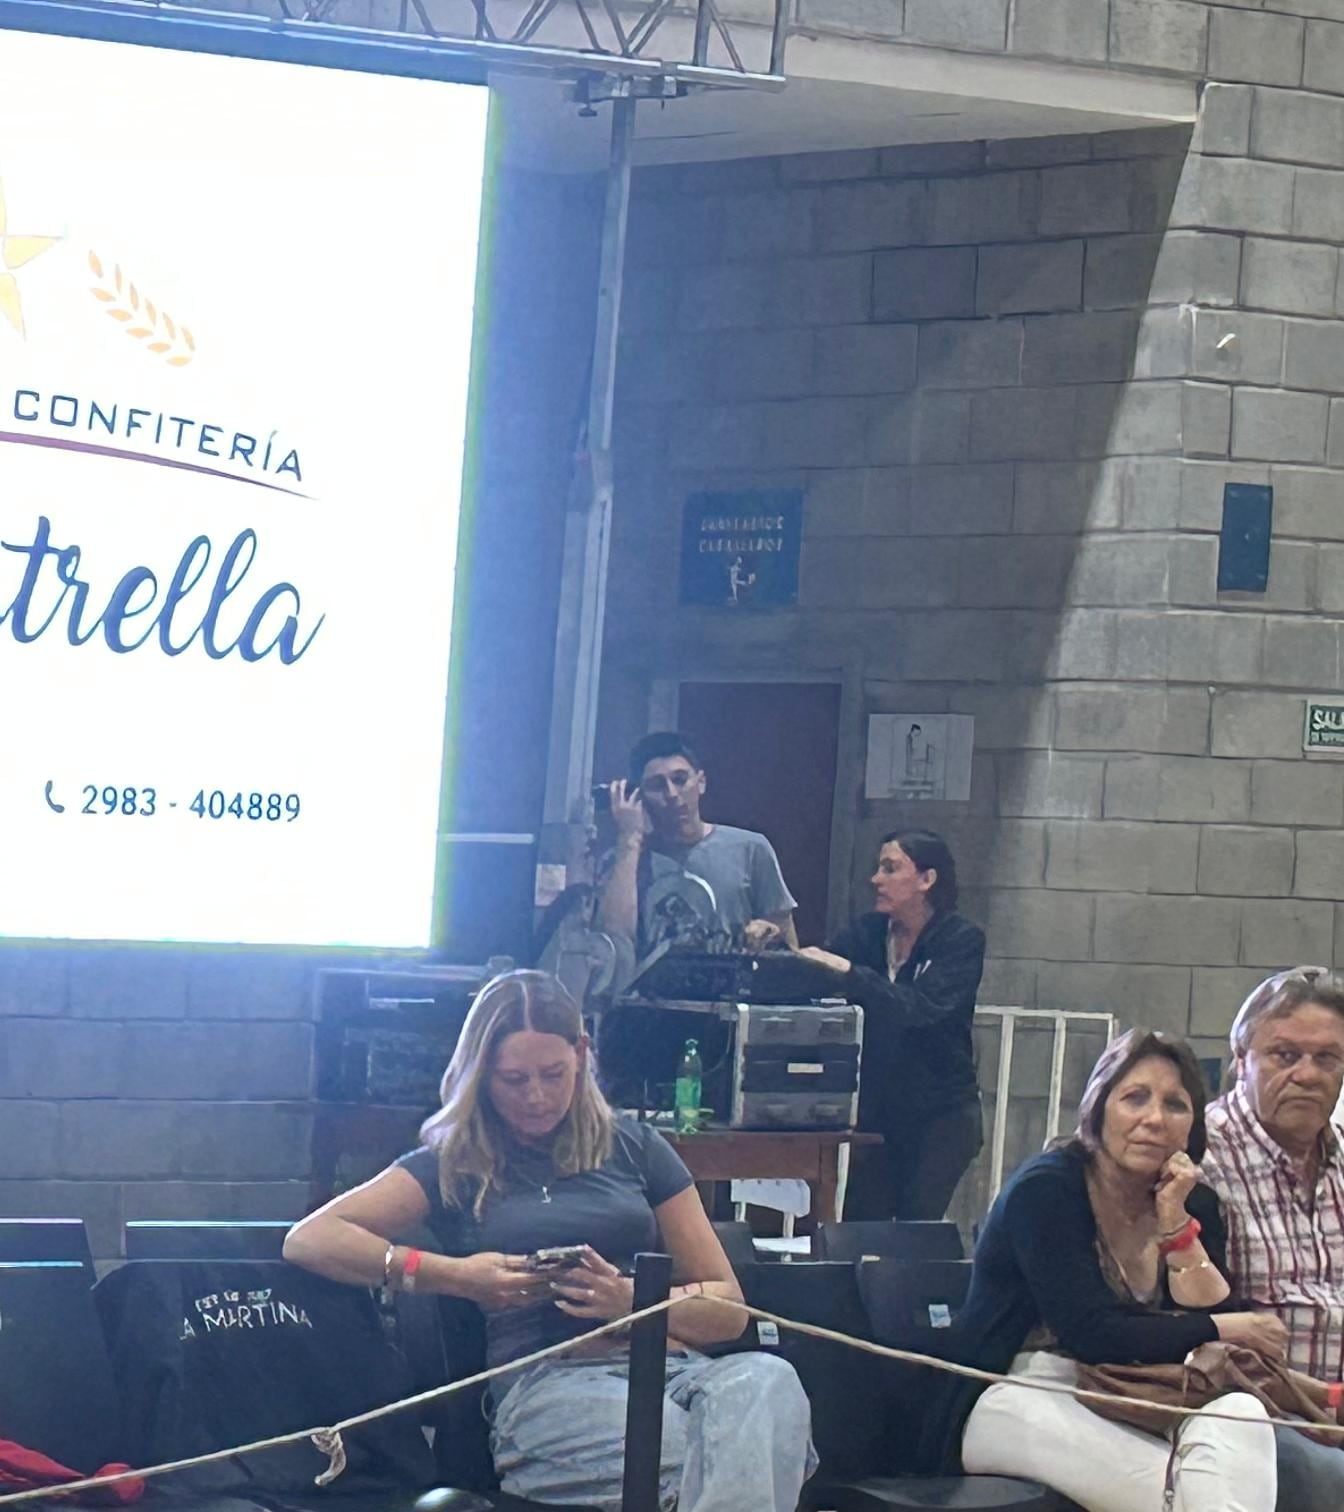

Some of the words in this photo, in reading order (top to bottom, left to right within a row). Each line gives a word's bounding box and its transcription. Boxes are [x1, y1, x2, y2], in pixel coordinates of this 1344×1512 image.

[13, 388, 304, 484] CONFITERÍA
[81, 783, 158, 817] 2983
[188, 788, 302, 823] 404889
